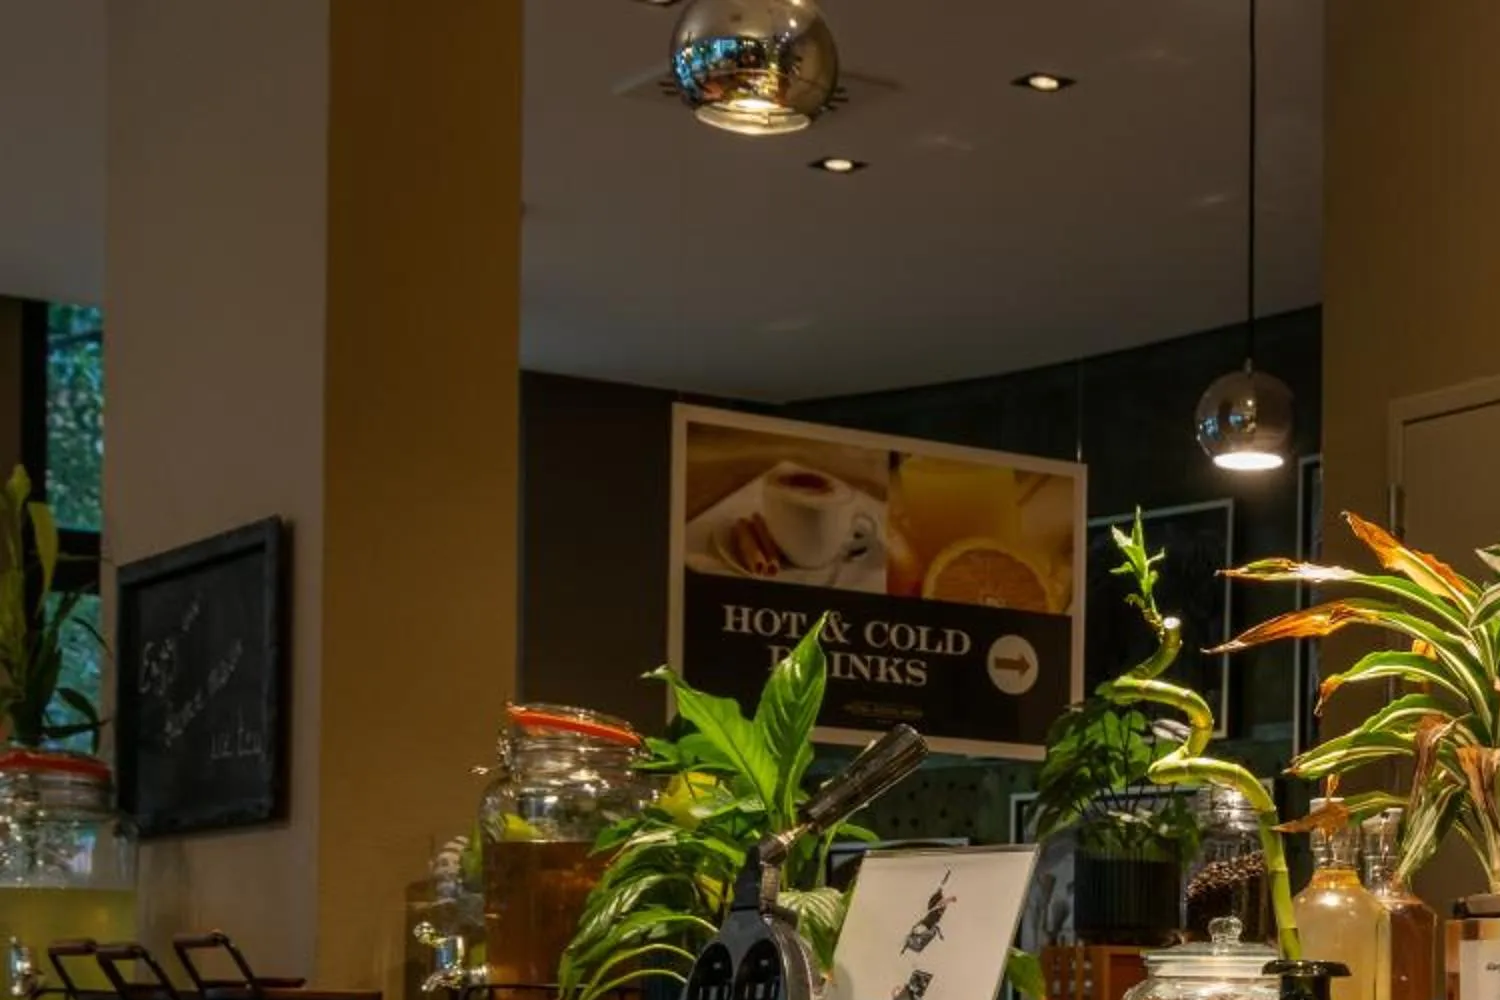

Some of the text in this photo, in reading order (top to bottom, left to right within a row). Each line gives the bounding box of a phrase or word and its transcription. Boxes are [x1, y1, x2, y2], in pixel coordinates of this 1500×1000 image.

[722, 604, 970, 656] HOT & COLD
